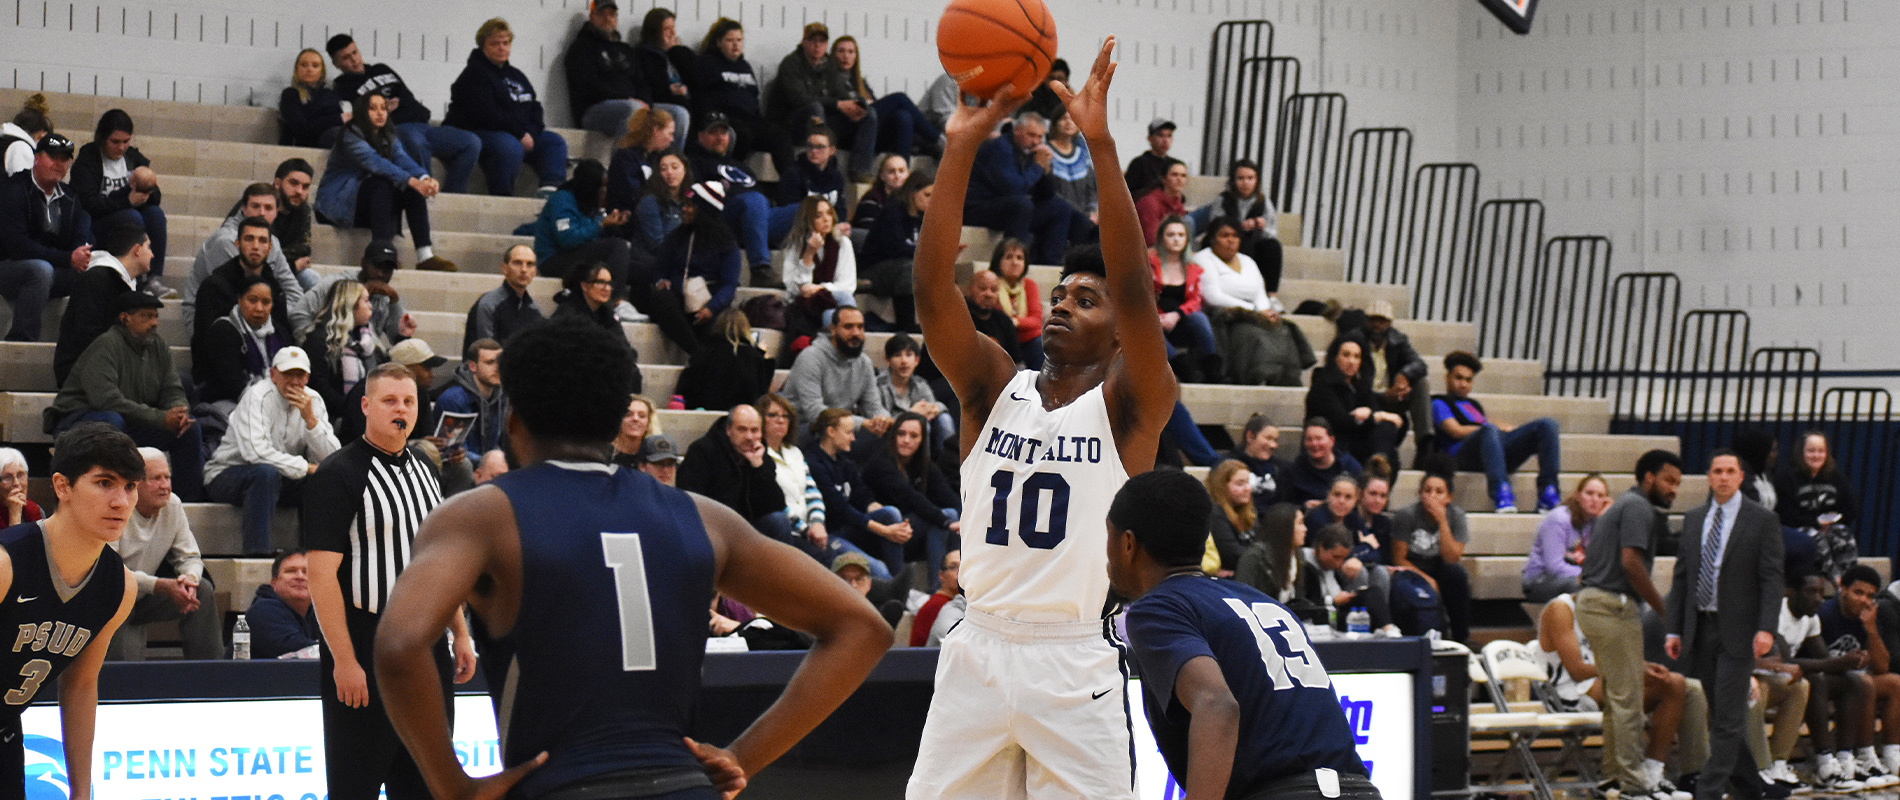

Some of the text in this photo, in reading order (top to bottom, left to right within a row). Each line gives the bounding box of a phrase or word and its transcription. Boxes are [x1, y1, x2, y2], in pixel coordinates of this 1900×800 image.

[985, 427, 1101, 465] MONT ALTO
[985, 469, 1070, 550] 10
[600, 532, 656, 671] 1
[12, 621, 91, 657] PSUD
[1222, 597, 1331, 690] 13
[4, 659, 52, 705] 3
[103, 748, 196, 780] PENN
[209, 745, 313, 777] STATE
